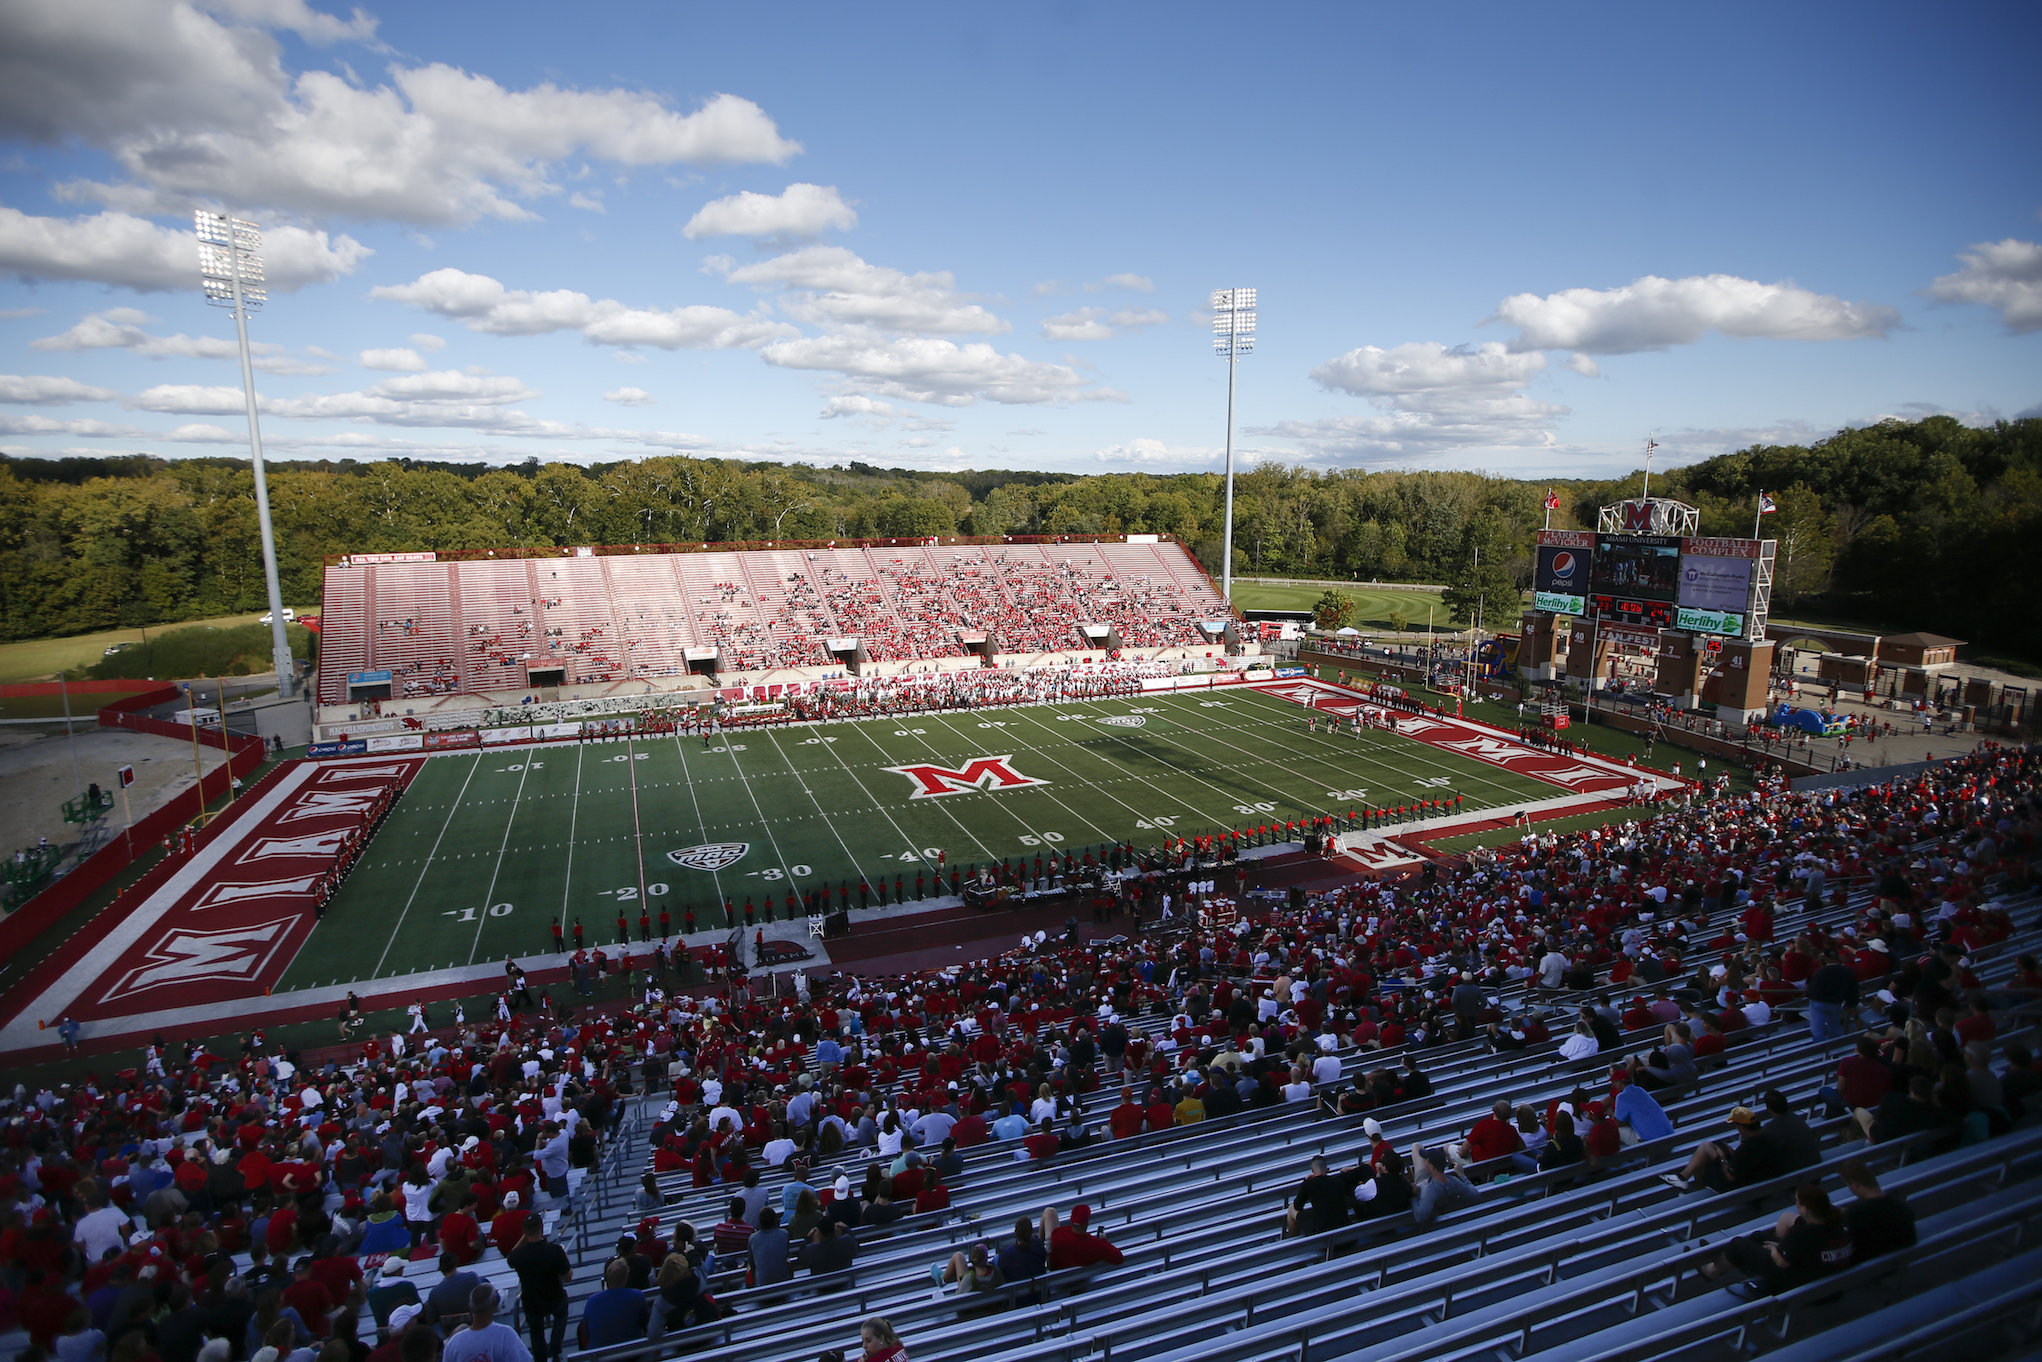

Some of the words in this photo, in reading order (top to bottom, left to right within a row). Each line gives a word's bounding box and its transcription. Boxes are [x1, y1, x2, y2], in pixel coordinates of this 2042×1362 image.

[1622, 502, 1657, 531] M
[1550, 532, 1581, 540] LARRY
[1630, 537, 1669, 545] UNIVERSITY
[1542, 538, 1589, 548] McVICKER
[1689, 538, 1752, 549] FOOTBALL
[1690, 546, 1749, 557] COMPLEX
[1551, 579, 1573, 587] pepsi
[1536, 597, 1569, 610] Herlihy
[1650, 608, 1663, 617] 24
[1526, 624, 1535, 633] 42
[1678, 614, 1721, 631] Herlihy
[1575, 632, 1585, 640] 40
[1600, 630, 1624, 641] FAN
[1626, 634, 1656, 646] FEST
[1668, 646, 1674, 654] 7
[1707, 641, 1722, 651] 25
[1732, 656, 1743, 666] 41
[343, 722, 395, 735] CHAMPIONSHIPS
[610, 751, 650, 763] 20
[507, 761, 545, 773] 10
[878, 754, 1053, 800] M
[1412, 776, 1446, 789] 10
[1326, 788, 1367, 801] 20
[1233, 801, 1276, 816] 30
[1136, 815, 1176, 830] 40
[1018, 831, 1065, 847] 50
[680, 849, 741, 863] MAC
[899, 847, 941, 863] 40
[1347, 841, 1409, 864] M
[761, 864, 813, 881] 30
[97, 762, 412, 1005] MIAMI
[617, 883, 670, 901] 20
[457, 903, 514, 923] 10
